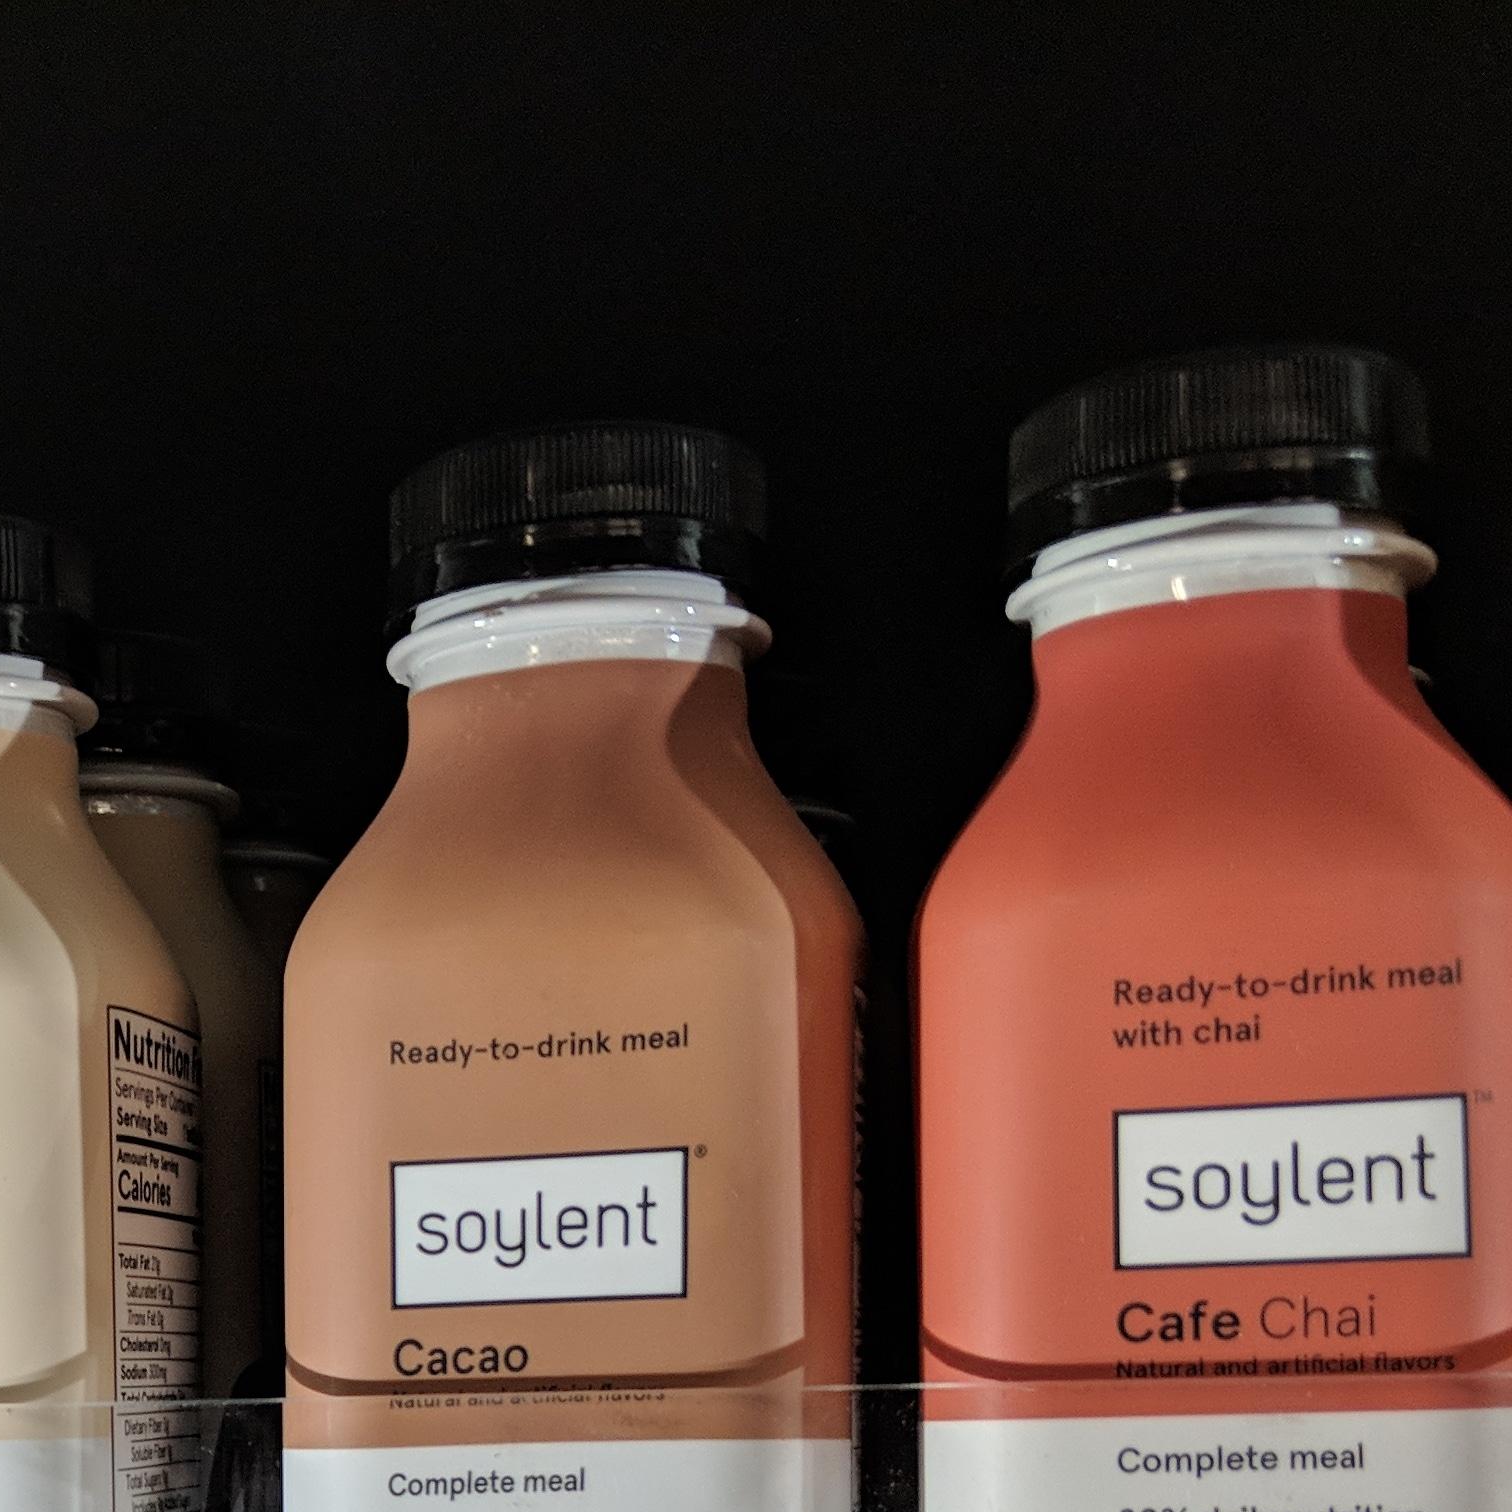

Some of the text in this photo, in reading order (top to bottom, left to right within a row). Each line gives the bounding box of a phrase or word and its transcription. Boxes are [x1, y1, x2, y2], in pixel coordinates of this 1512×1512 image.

[1114, 958, 1463, 1008] Ready-to-drink meal
[114, 1018, 189, 1081] Nutrition
[390, 1023, 688, 1068] Ready-to-drink meal
[1114, 1015, 1261, 1048] with chai
[118, 1168, 171, 1206] Calories
[1145, 1134, 1437, 1226] soylent
[417, 1185, 657, 1268] soylent
[1117, 1294, 1376, 1343] Cafe Chai
[394, 1338, 529, 1377] Cacao
[1116, 1351, 1456, 1379] Natural and artificial flavors
[1117, 1443, 1365, 1479] Complete meal
[388, 1468, 586, 1500] Complete meal
